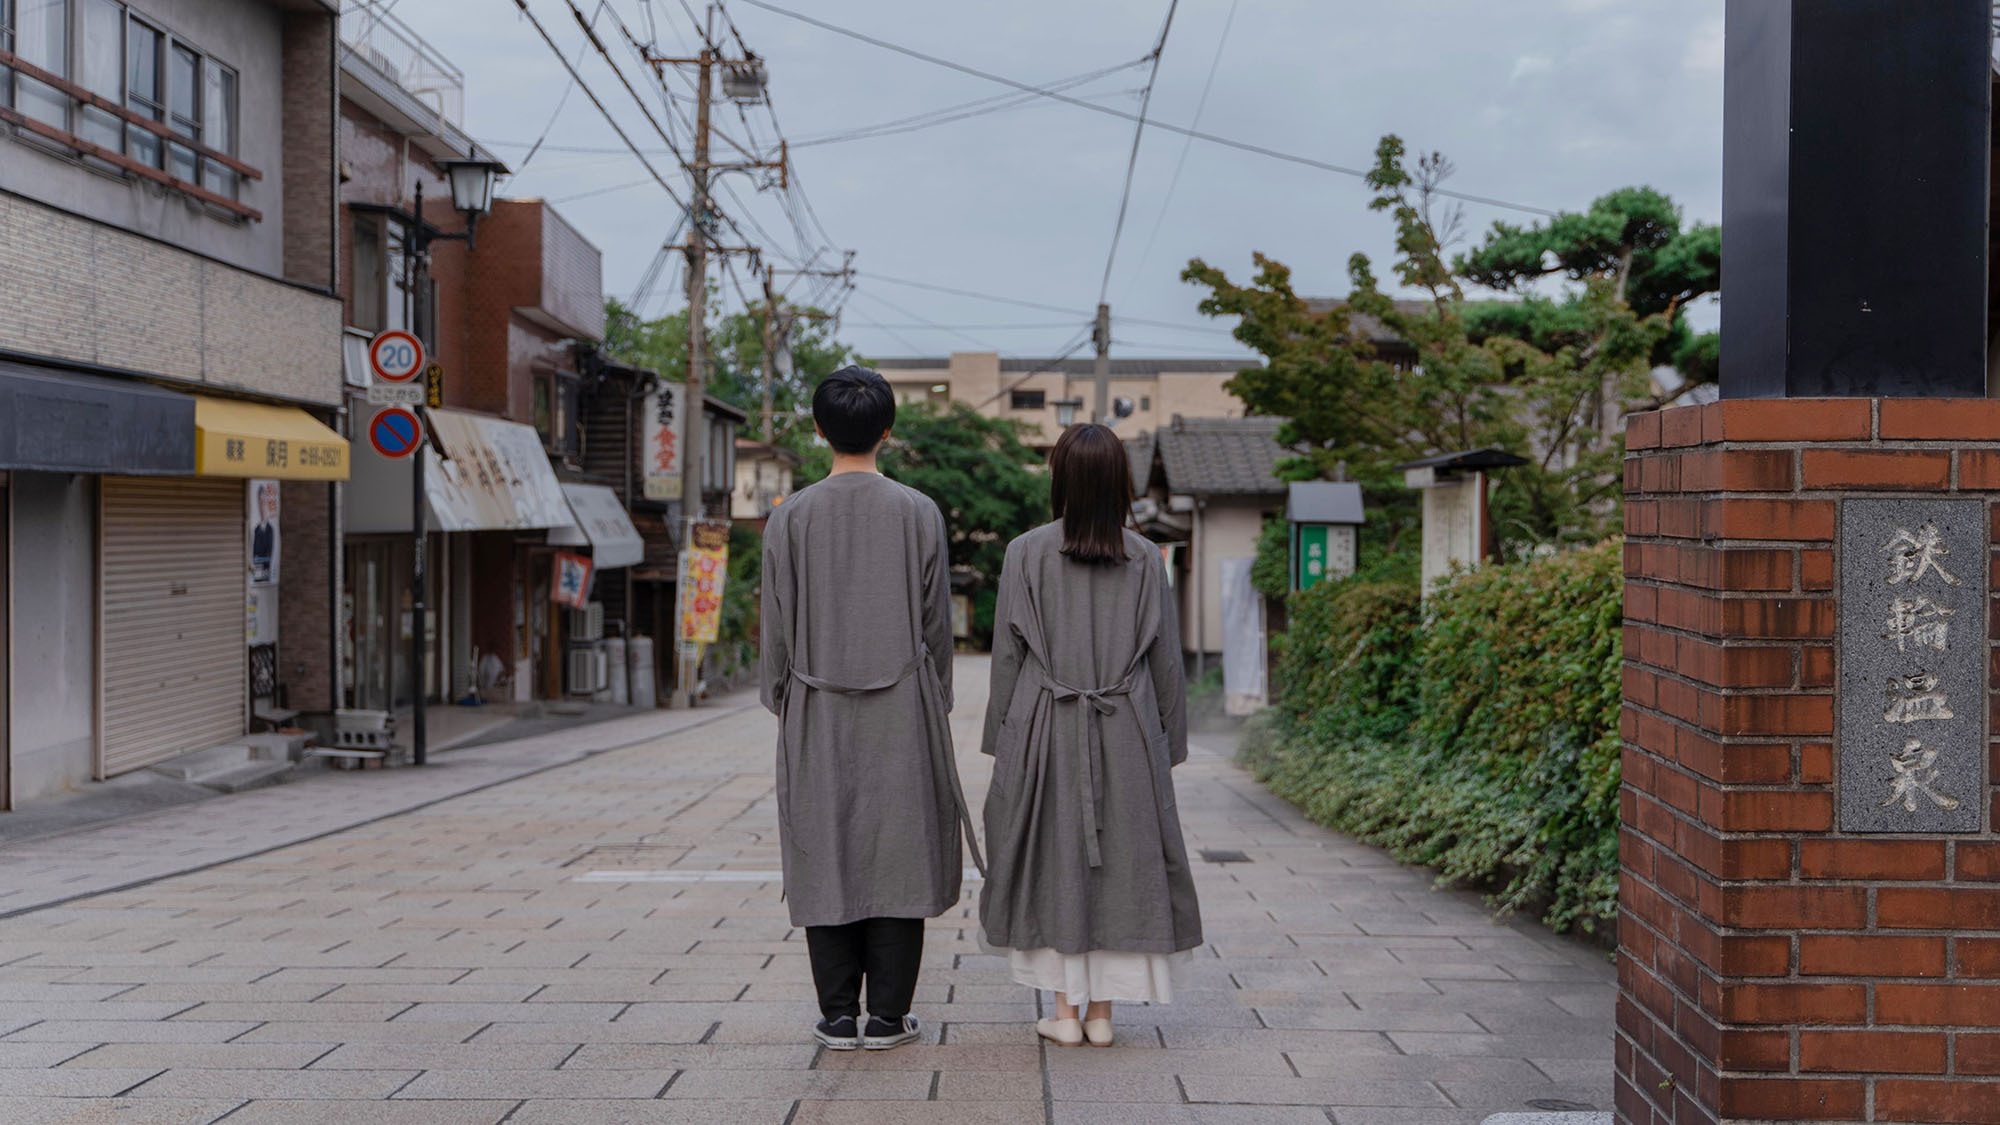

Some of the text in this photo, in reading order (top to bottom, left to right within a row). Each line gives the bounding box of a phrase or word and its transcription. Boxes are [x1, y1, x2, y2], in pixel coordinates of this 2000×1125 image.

[382, 344, 412, 368] 20
[370, 387, 419, 401] ここから
[1878, 519, 1963, 813] 鉄輪温泉
